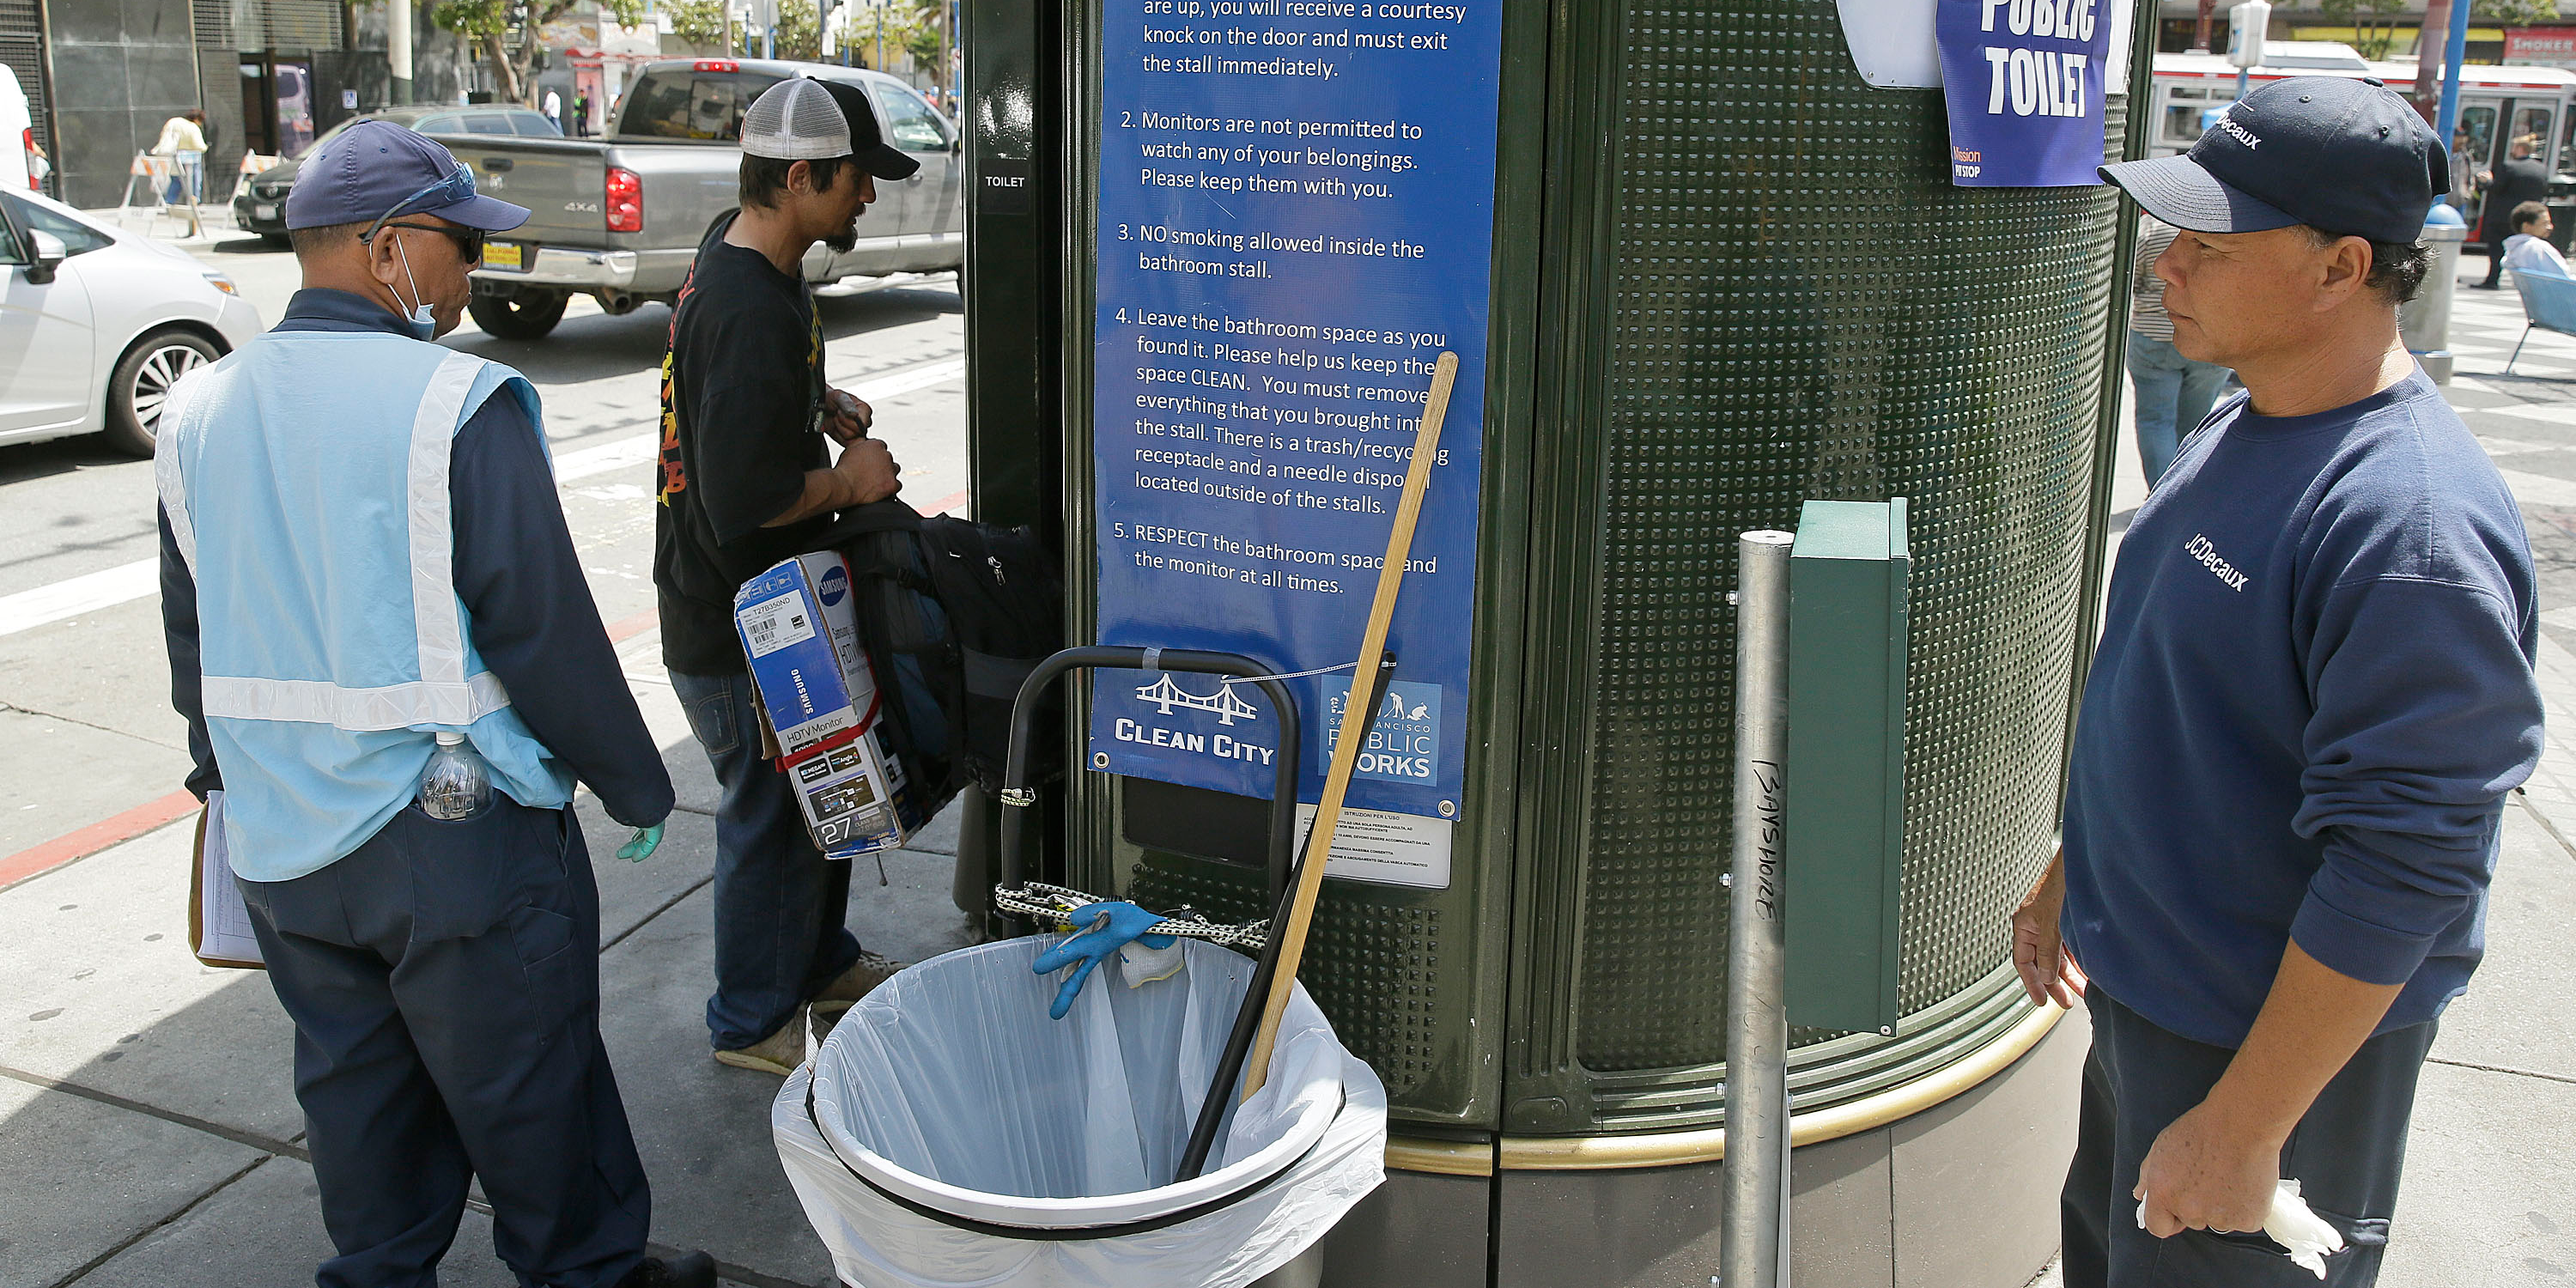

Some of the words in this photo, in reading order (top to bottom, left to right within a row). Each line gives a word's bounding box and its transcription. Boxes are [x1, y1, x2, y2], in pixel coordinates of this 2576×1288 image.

[1144, 0, 1172, 15] are
[1177, 1, 1205, 19] up,
[1210, 1, 1242, 19] you
[1248, 0, 1279, 15] will
[1285, 0, 1355, 17] receive
[1361, 3, 1372, 18] a
[1379, 2, 1467, 24] courtesy
[1144, 24, 1194, 44] knock
[1199, 30, 1221, 44] on
[1226, 26, 1257, 45] the
[1262, 27, 1307, 46] door
[1312, 28, 1348, 47] and
[1355, 32, 1405, 49] must
[1411, 31, 1449, 50] exit
[1142, 53, 1171, 72] the
[1176, 54, 1212, 73] stall
[1218, 57, 1339, 81] immediately.
[1984, 46, 2087, 118] TOILET
[1121, 111, 1136, 128] 2.
[1142, 112, 1220, 131] Monitors
[1225, 118, 1255, 133] are
[1261, 118, 1292, 135] not
[1298, 118, 1395, 139] permitted
[1400, 123, 1422, 140] to
[1141, 141, 1192, 159] watch
[1197, 147, 1230, 165] any
[1234, 143, 1255, 162] of
[1257, 149, 1302, 167] your
[1307, 146, 1418, 173] belongings.
[985, 176, 1025, 187] TOILET
[1141, 167, 1194, 188] Please
[1200, 170, 1242, 195] keep
[1248, 173, 1297, 193] them
[1303, 177, 1346, 196] with
[1351, 183, 1393, 201] you.
[1118, 223, 1133, 240] 3.
[1140, 225, 1167, 244] NO
[1171, 228, 1244, 252] smoking
[1249, 231, 1323, 253] allowed
[1329, 236, 1386, 257] inside
[1391, 239, 1425, 258] the
[1139, 252, 1223, 276] bathroom
[1229, 260, 1272, 279] stall.
[1115, 307, 1132, 325] 4.
[1138, 308, 1188, 328] Leave
[1191, 313, 1219, 332] the
[1224, 315, 1316, 339] bathroom
[1322, 327, 1377, 345] space
[1382, 331, 1404, 345] as
[1409, 332, 1445, 349] you
[1136, 335, 1188, 356] found
[1194, 340, 1209, 359] it.
[1214, 343, 1272, 364] Please
[1278, 347, 1318, 372] help
[1324, 355, 1345, 370] us
[1351, 352, 1397, 377] keep
[1403, 356, 1435, 375] the
[1136, 367, 1186, 385] space
[1191, 368, 1251, 392] CLEAN.
[1261, 375, 1297, 395] You
[1303, 382, 1351, 399] must
[1356, 386, 1429, 404] remove
[1136, 394, 1227, 420] everything
[1230, 400, 1269, 421] that
[1273, 409, 1308, 426] you
[1315, 406, 1391, 433] brought
[1396, 413, 1422, 431] int
[1134, 417, 1165, 436] the
[1170, 422, 1209, 441] stall.
[1213, 426, 1264, 448] There
[1270, 432, 1284, 450] is
[1289, 438, 1299, 452] a
[1304, 435, 1449, 466] trash/recycg
[1135, 448, 1224, 471] receptacle
[1229, 459, 1261, 476] and
[1267, 465, 1277, 477] a
[1284, 464, 1347, 483] needle
[1352, 467, 1431, 490] dispol
[1135, 471, 1199, 494] located
[1204, 483, 1267, 504] outside
[1272, 489, 1292, 507] of
[1296, 490, 1327, 509] the
[1333, 495, 1386, 514] stalls.
[1114, 522, 1129, 538] 5.
[1135, 525, 1209, 549] RESPECT
[1212, 534, 1240, 554] the
[1245, 538, 1335, 566] bathroom
[1340, 553, 1384, 571] spac
[1401, 556, 1437, 574] and
[2184, 532, 2250, 592] JCDecaux
[820, 575, 847, 595] SAMSUNG
[1134, 550, 1163, 568] the
[1169, 558, 1236, 580] monitor
[1240, 568, 1257, 584] at
[1261, 570, 1282, 587] all
[1286, 574, 1344, 593] times.
[791, 668, 814, 714] SAMSUNG
[787, 726, 811, 743] HDTV
[811, 717, 843, 734] Monitor
[1115, 718, 1205, 753] CLEAN
[1213, 734, 1274, 766] CITY
[1327, 728, 1431, 755] PBLIC
[1376, 721, 1431, 732] ANCISCO
[1327, 750, 1431, 778] ORKS
[821, 817, 851, 845] 27
